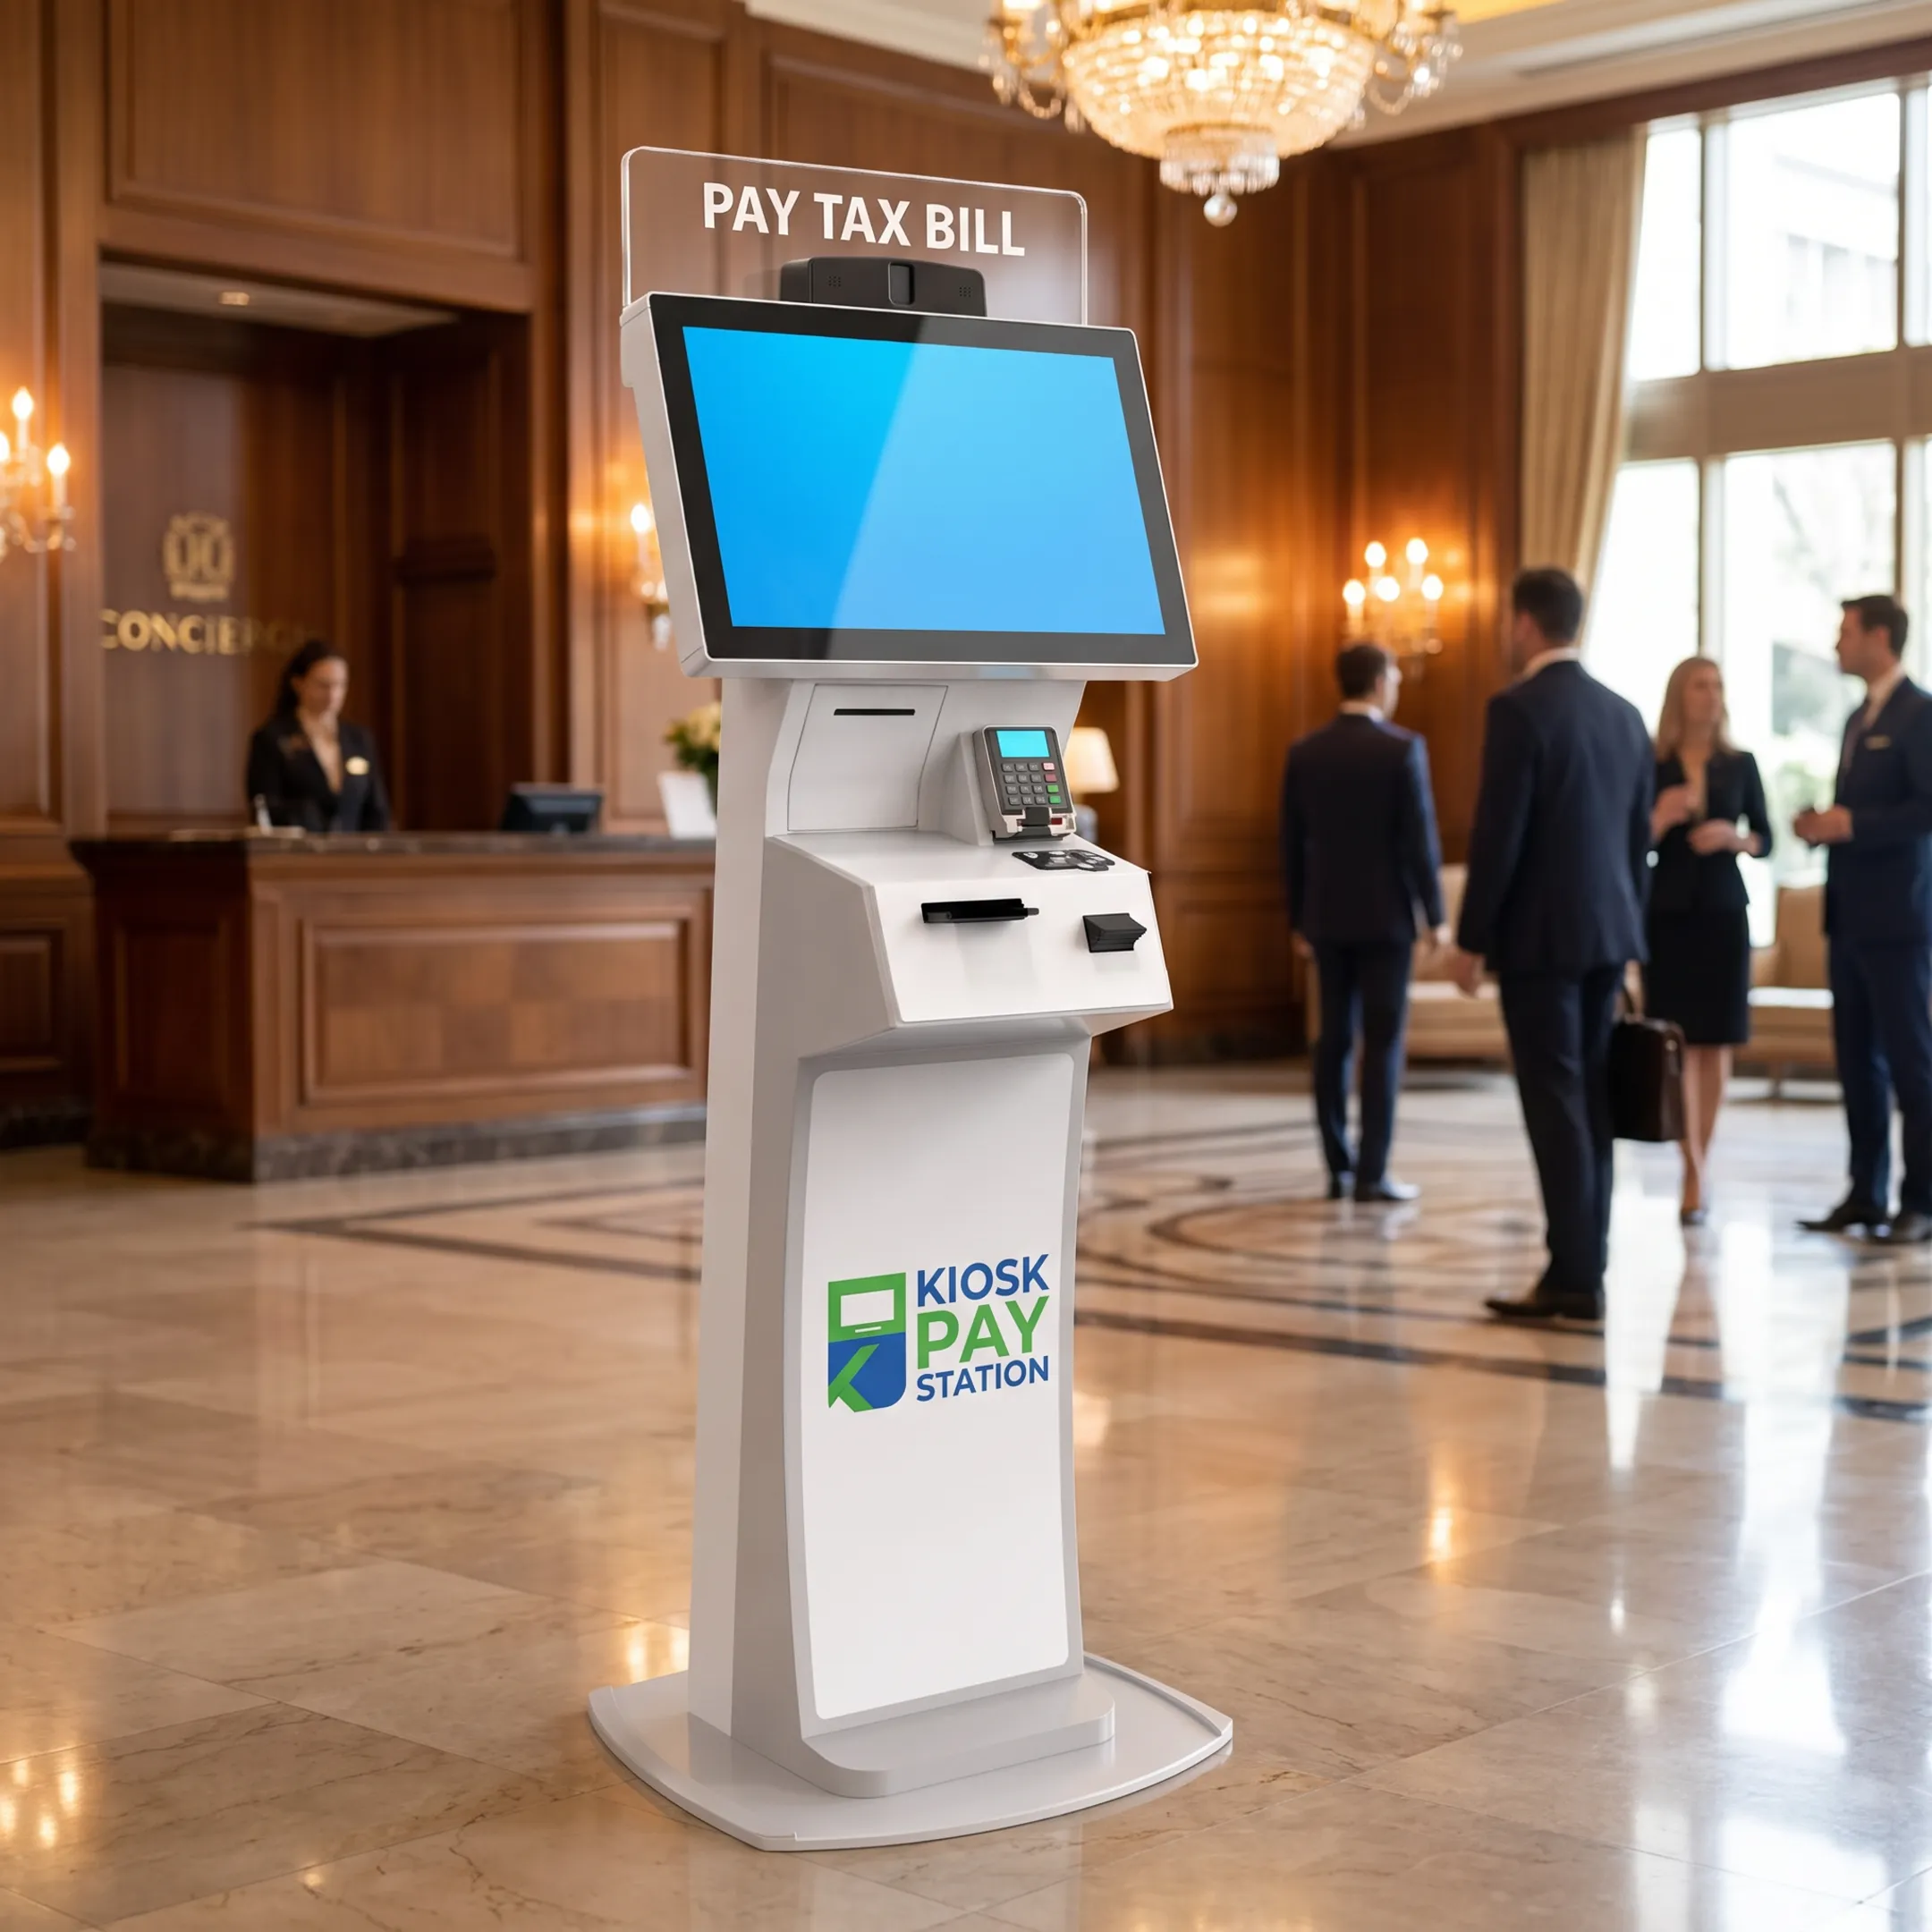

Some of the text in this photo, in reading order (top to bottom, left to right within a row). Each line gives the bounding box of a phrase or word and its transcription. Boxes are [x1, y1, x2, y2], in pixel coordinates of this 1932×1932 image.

[704, 182, 1026, 257] PAY TAX BILL
[917, 1253, 1049, 1308] KIOSK
[917, 1295, 1050, 1369] PAY
[916, 1355, 1049, 1402] STATION
